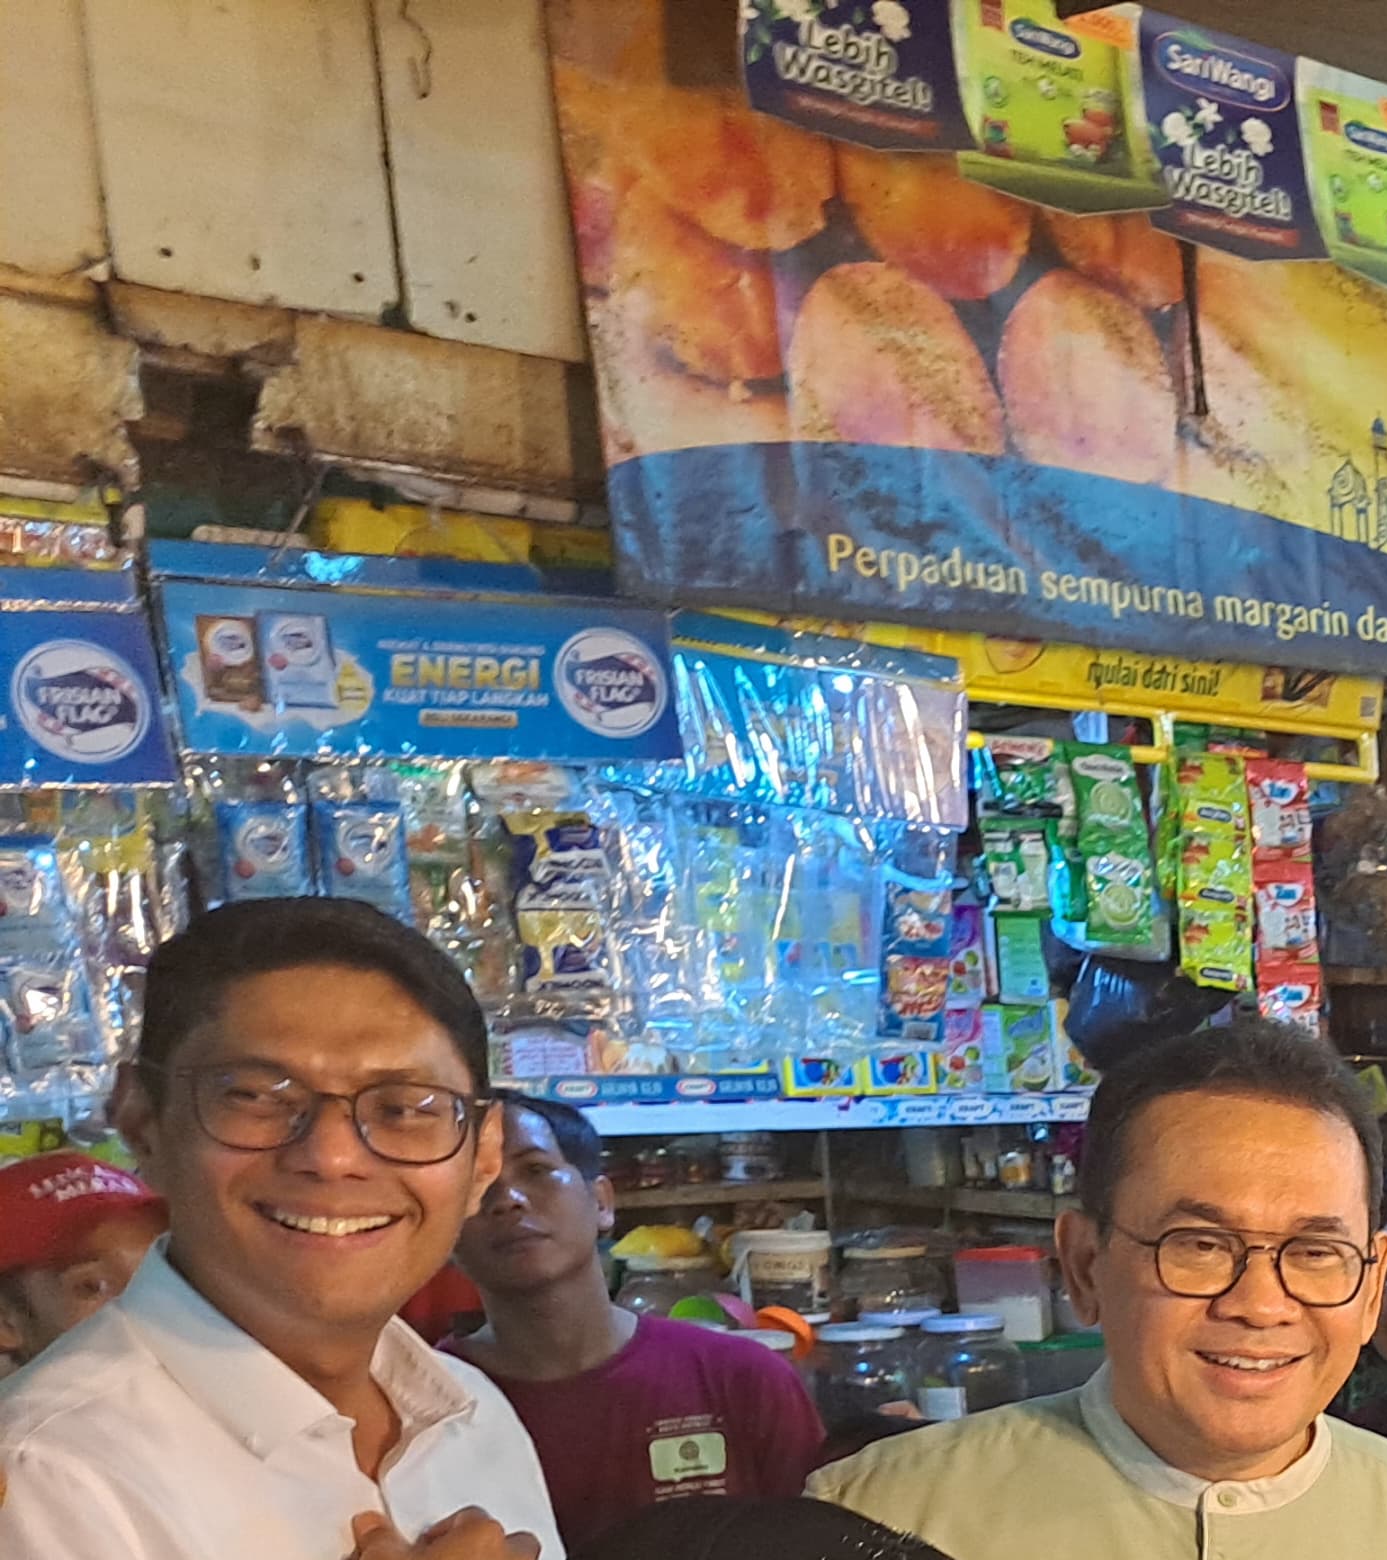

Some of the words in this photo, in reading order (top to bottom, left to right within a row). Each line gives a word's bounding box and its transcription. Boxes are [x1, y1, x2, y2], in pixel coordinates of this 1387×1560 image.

[800, 19, 896, 76] Lebih
[1167, 43, 1276, 101] SariWangi
[1186, 143, 1262, 185] Lebih
[827, 533, 1027, 592] Perpaduan
[1040, 570, 1204, 619] sempurna
[1215, 594, 1348, 641] margarin
[391, 653, 540, 690] ENERGI
[575, 669, 644, 687] FRISIAN
[1088, 656, 1137, 688] mulai
[1181, 665, 1222, 697] sini!
[37, 686, 121, 705] FRISIAN
